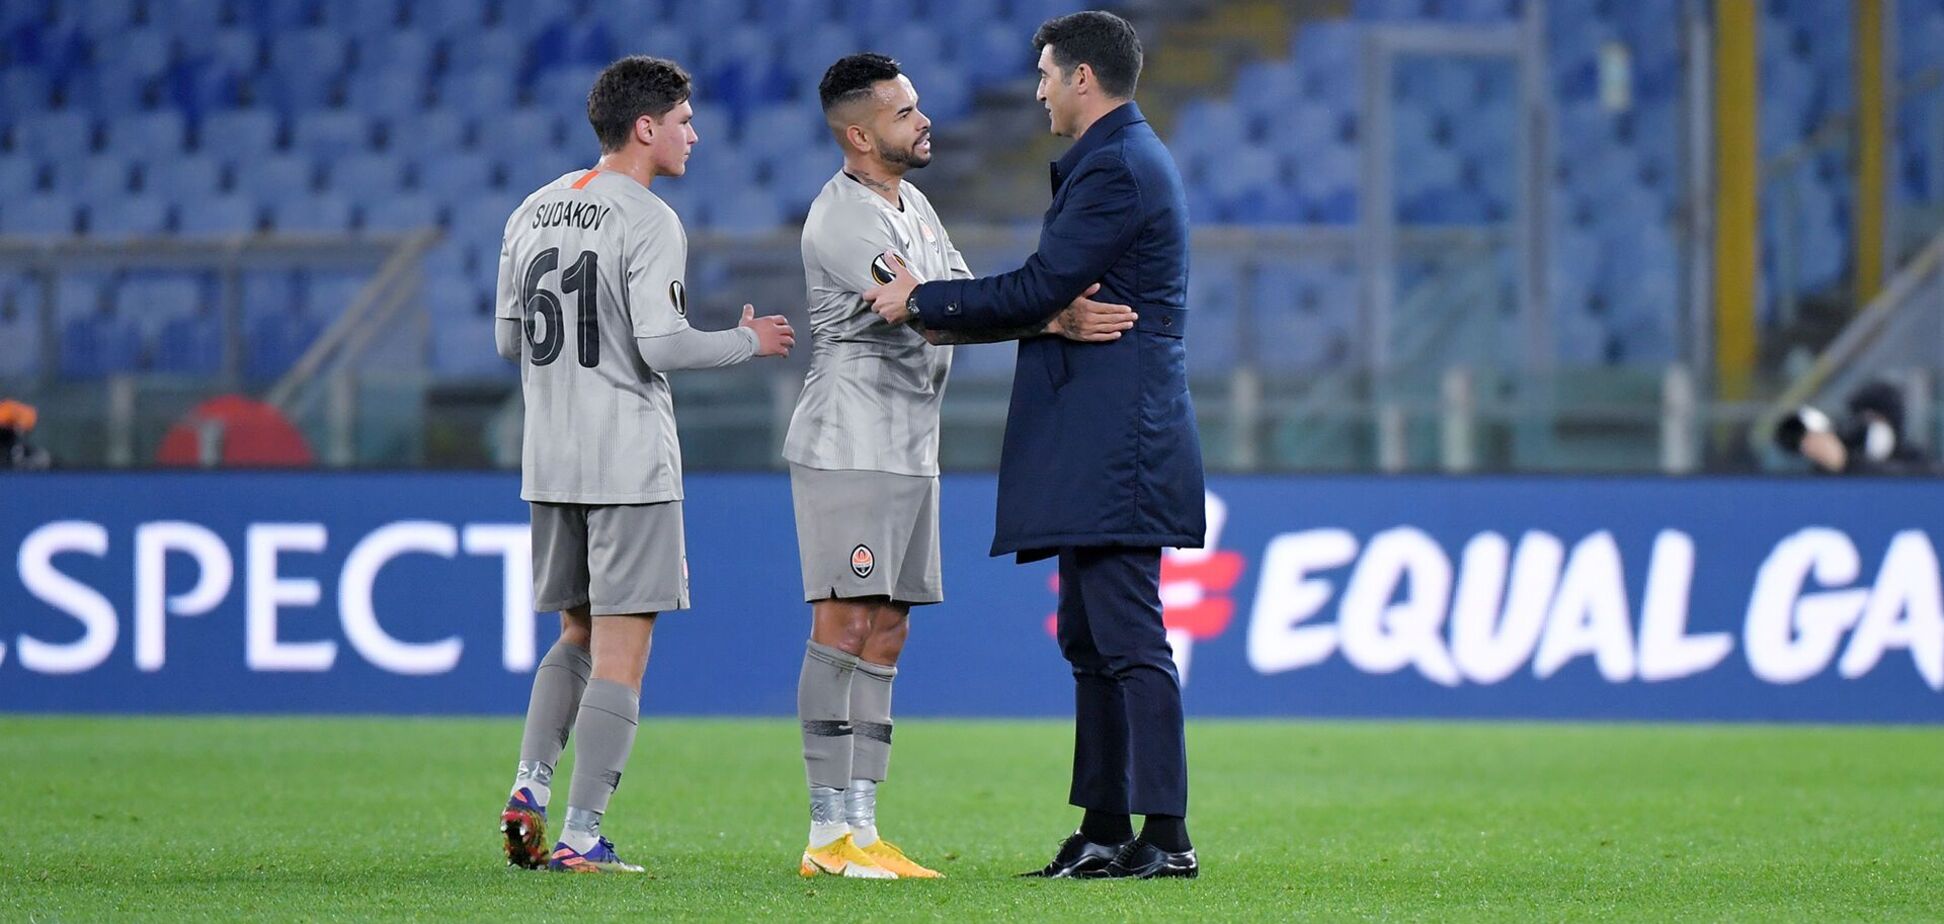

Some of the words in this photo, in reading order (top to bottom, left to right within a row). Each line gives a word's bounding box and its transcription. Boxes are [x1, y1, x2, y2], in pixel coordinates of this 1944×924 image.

[532, 200, 610, 231] SUDAKOV
[523, 247, 600, 369] 61
[0, 519, 536, 675] SPECT
[1246, 525, 1735, 687] EQUAL
[1743, 525, 1944, 692] GA
